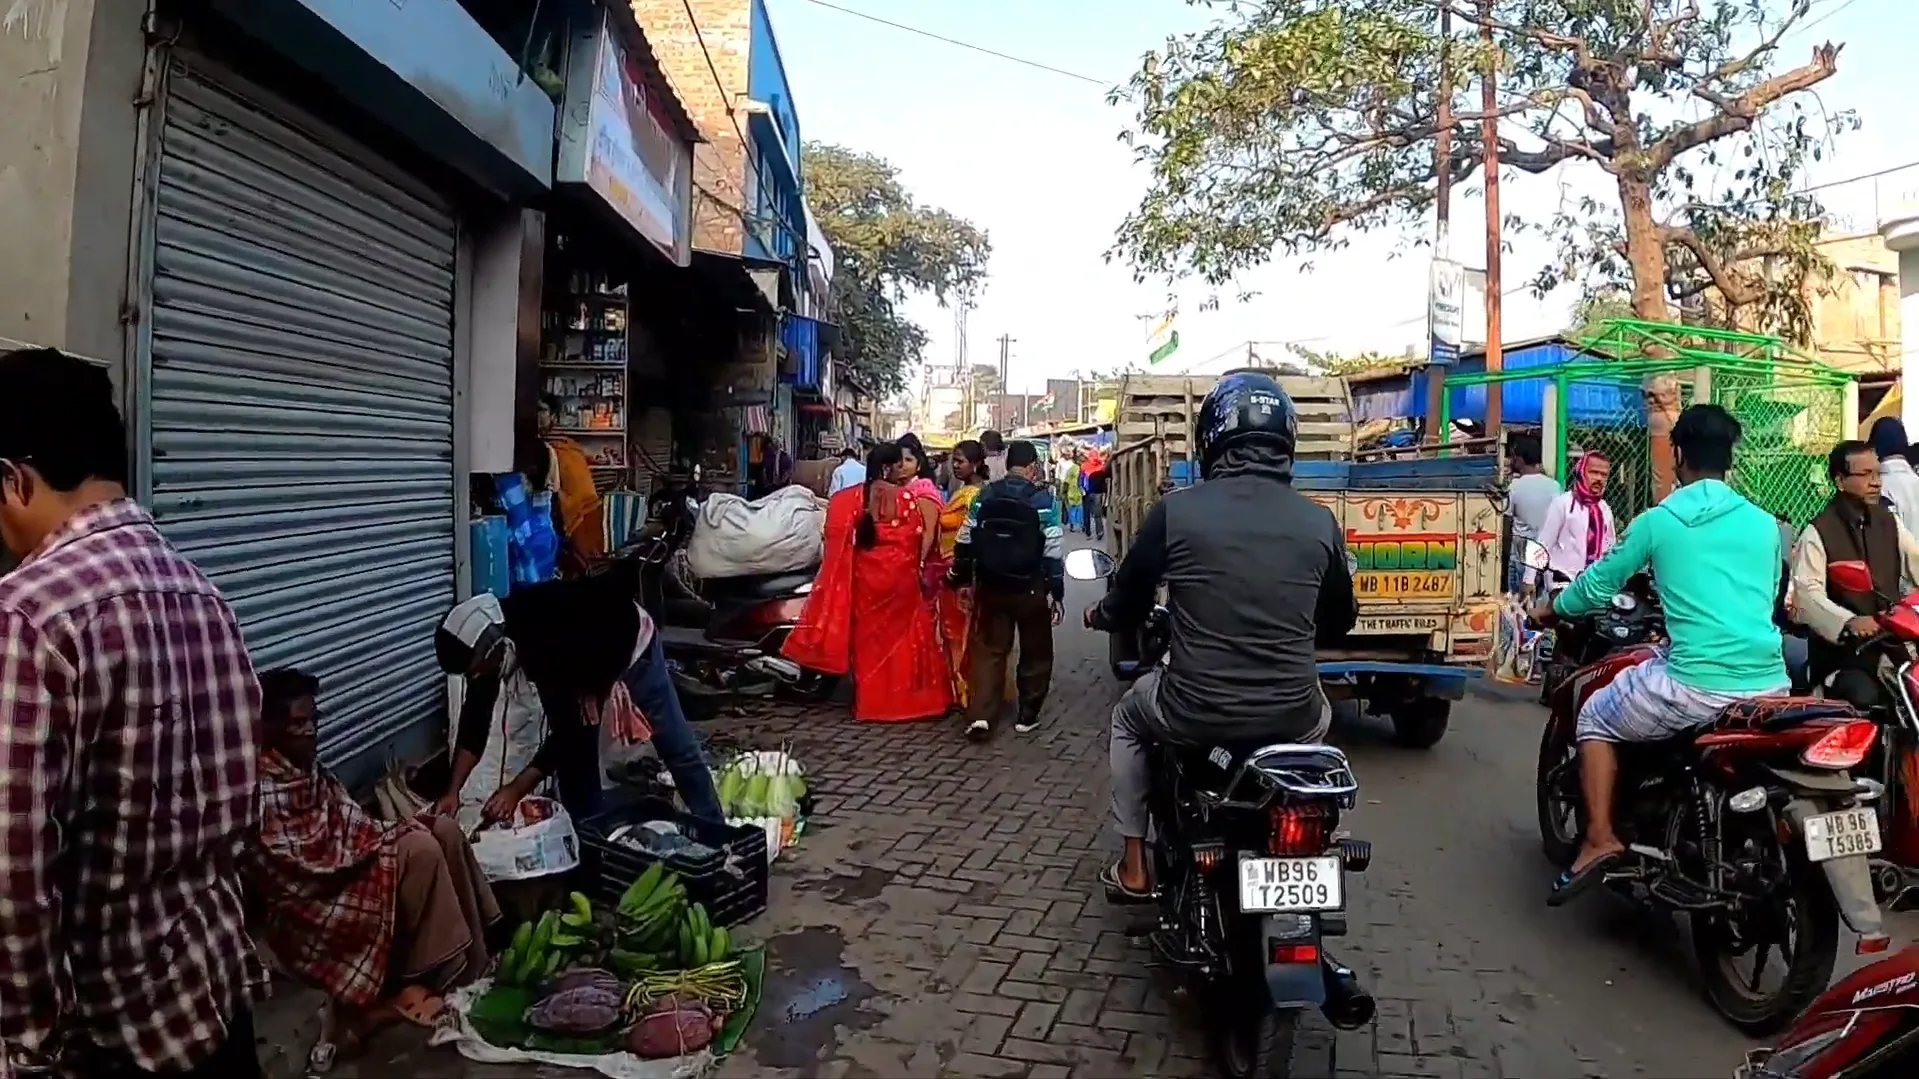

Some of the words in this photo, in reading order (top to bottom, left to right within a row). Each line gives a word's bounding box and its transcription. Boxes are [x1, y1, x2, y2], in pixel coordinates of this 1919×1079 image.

[1360, 576, 1378, 592] WB
[1384, 576, 1409, 591] 11B
[1413, 576, 1450, 592] 2487
[1360, 619, 1377, 631] THE
[1825, 816, 1844, 836] WB
[1848, 813, 1867, 831] 96
[1826, 832, 1874, 856] T5385
[1263, 861, 1318, 883] WB96
[1259, 884, 1328, 907] T2509
